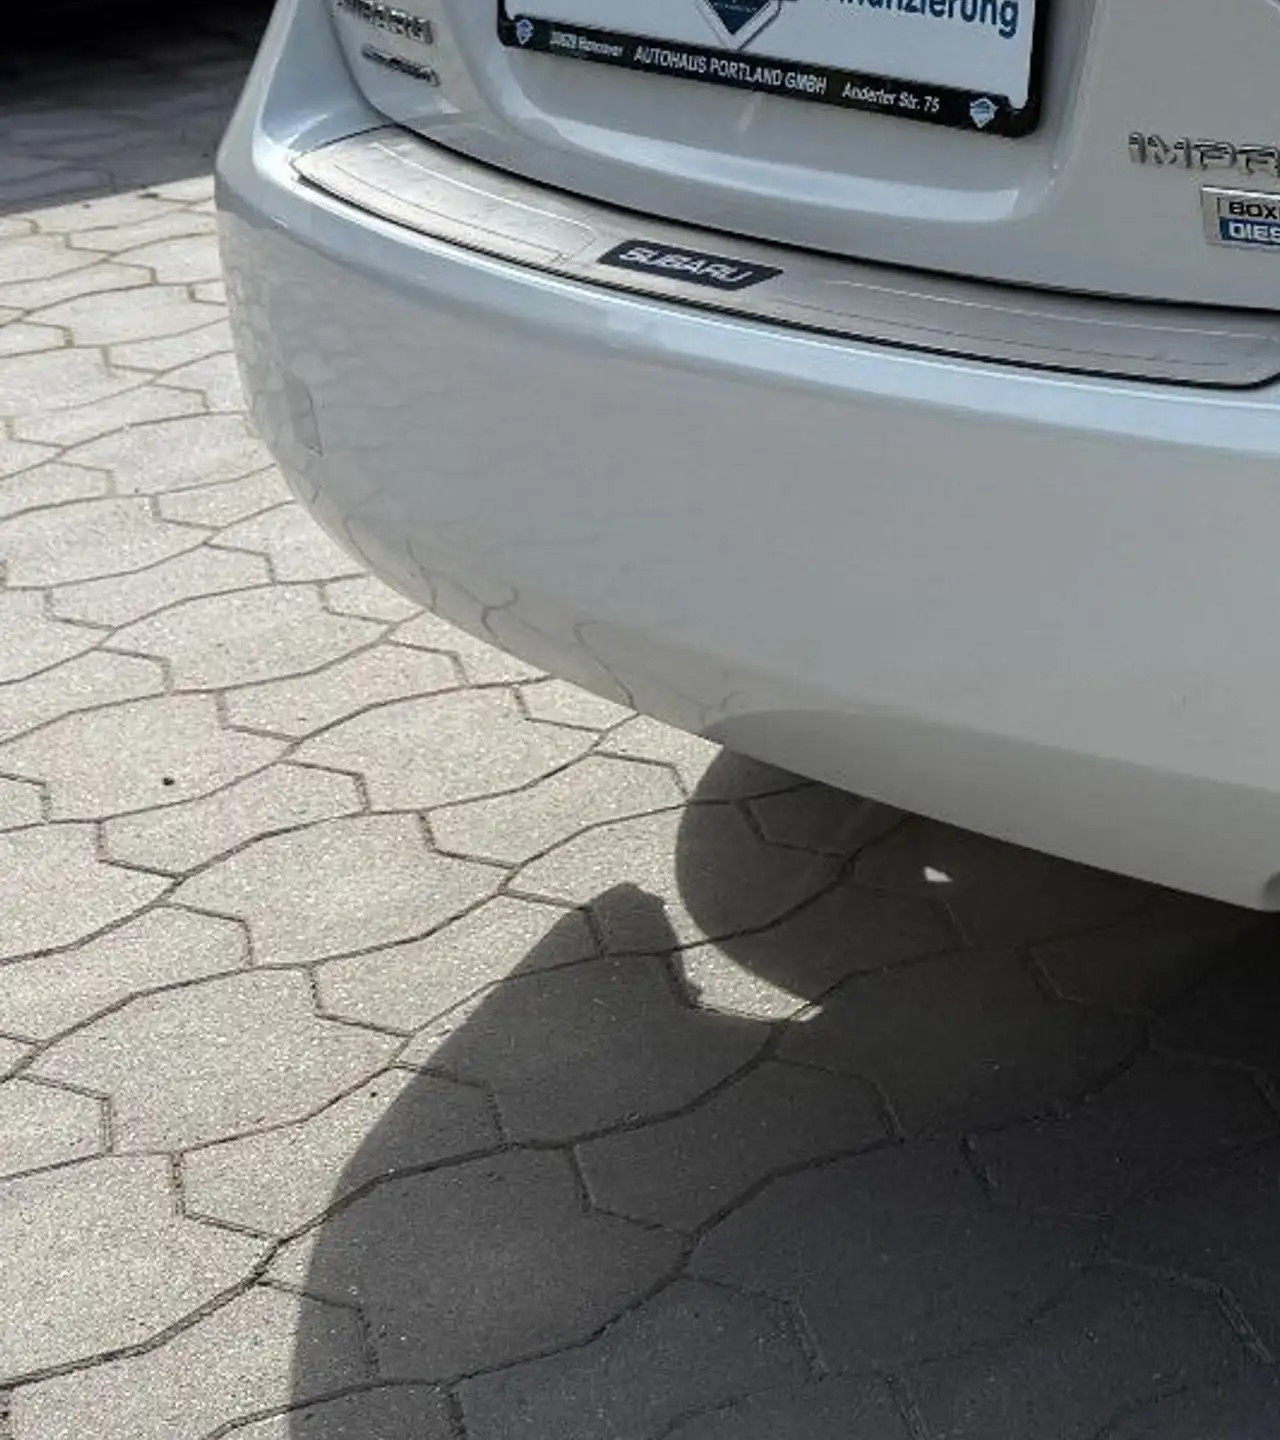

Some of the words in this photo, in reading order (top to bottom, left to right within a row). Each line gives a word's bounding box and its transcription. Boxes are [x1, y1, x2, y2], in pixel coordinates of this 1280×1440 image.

[633, 45, 707, 75] AUTOHAUS
[709, 57, 782, 87] PORTLAND
[784, 69, 828, 95] GMBH
[899, 92, 921, 110] Str.
[924, 95, 941, 113] 75
[619, 246, 754, 284] SUBARU
